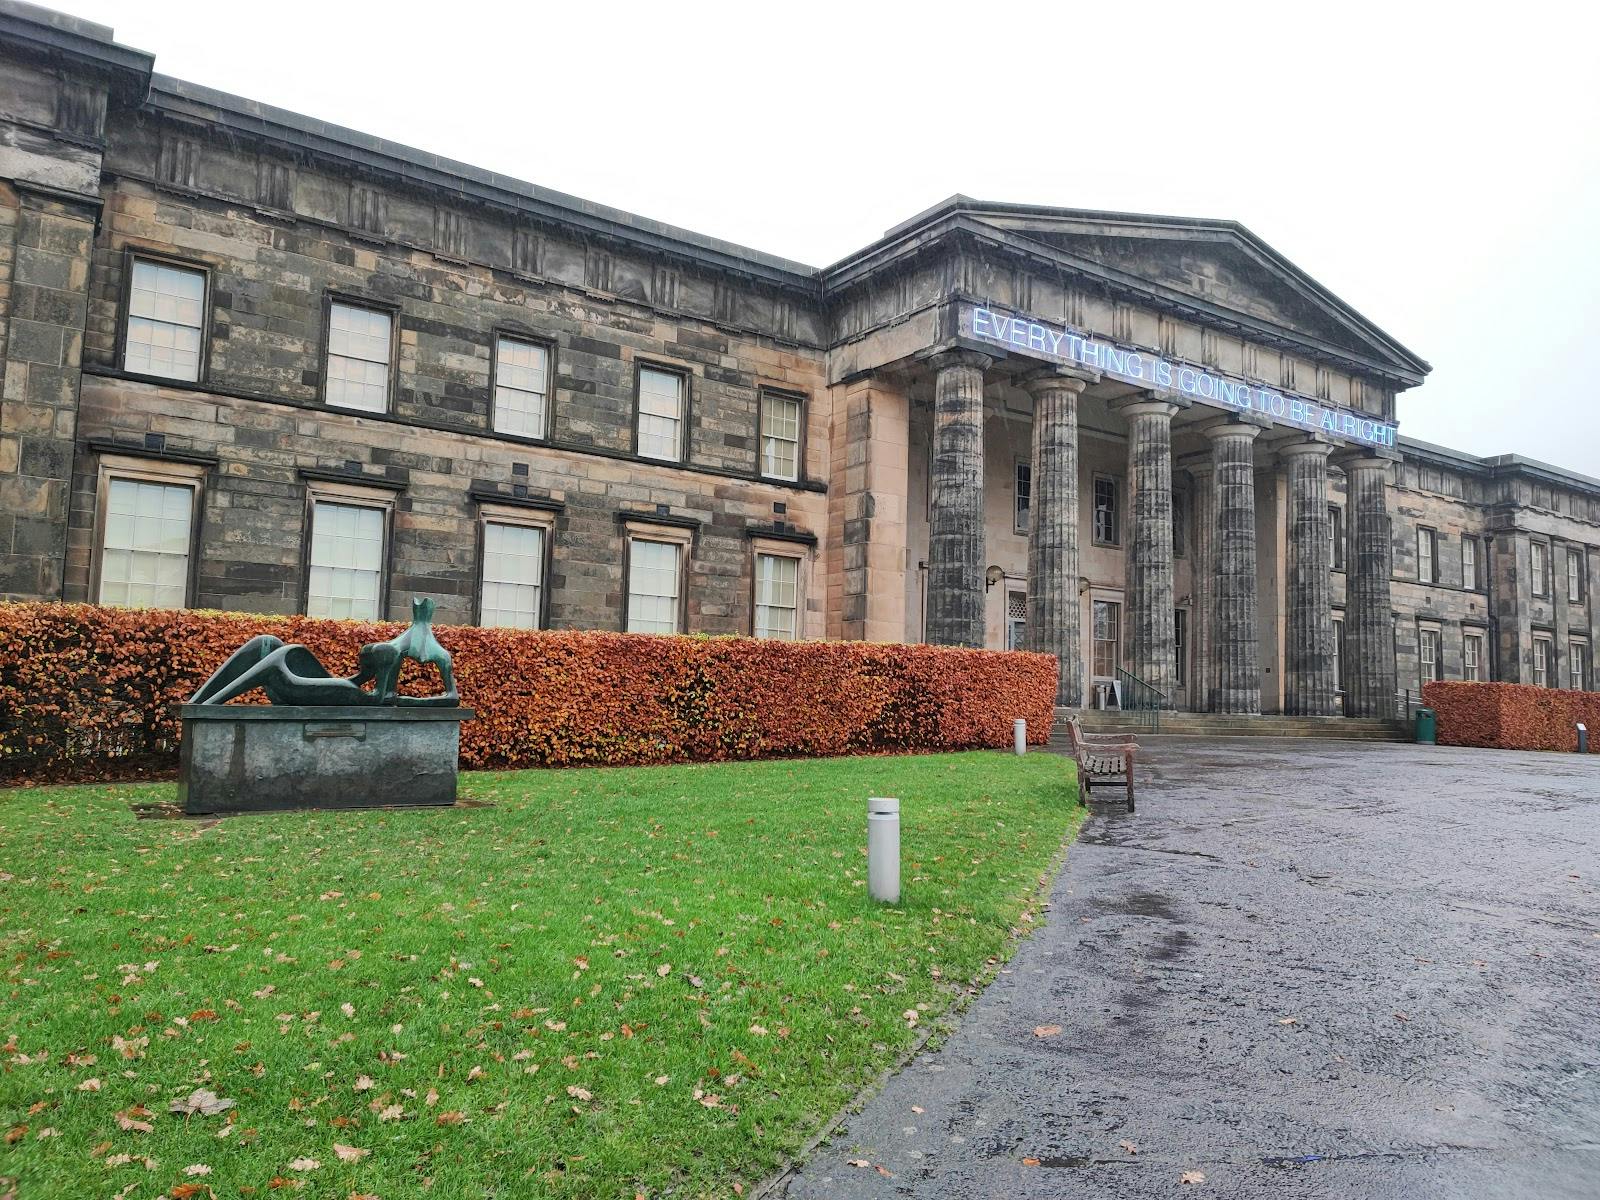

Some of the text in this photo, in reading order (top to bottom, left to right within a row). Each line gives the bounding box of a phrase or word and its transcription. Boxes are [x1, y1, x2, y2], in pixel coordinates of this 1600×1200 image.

[973, 308, 1396, 446] EVERYTHING IS GOING TO BE ALRIGHT
